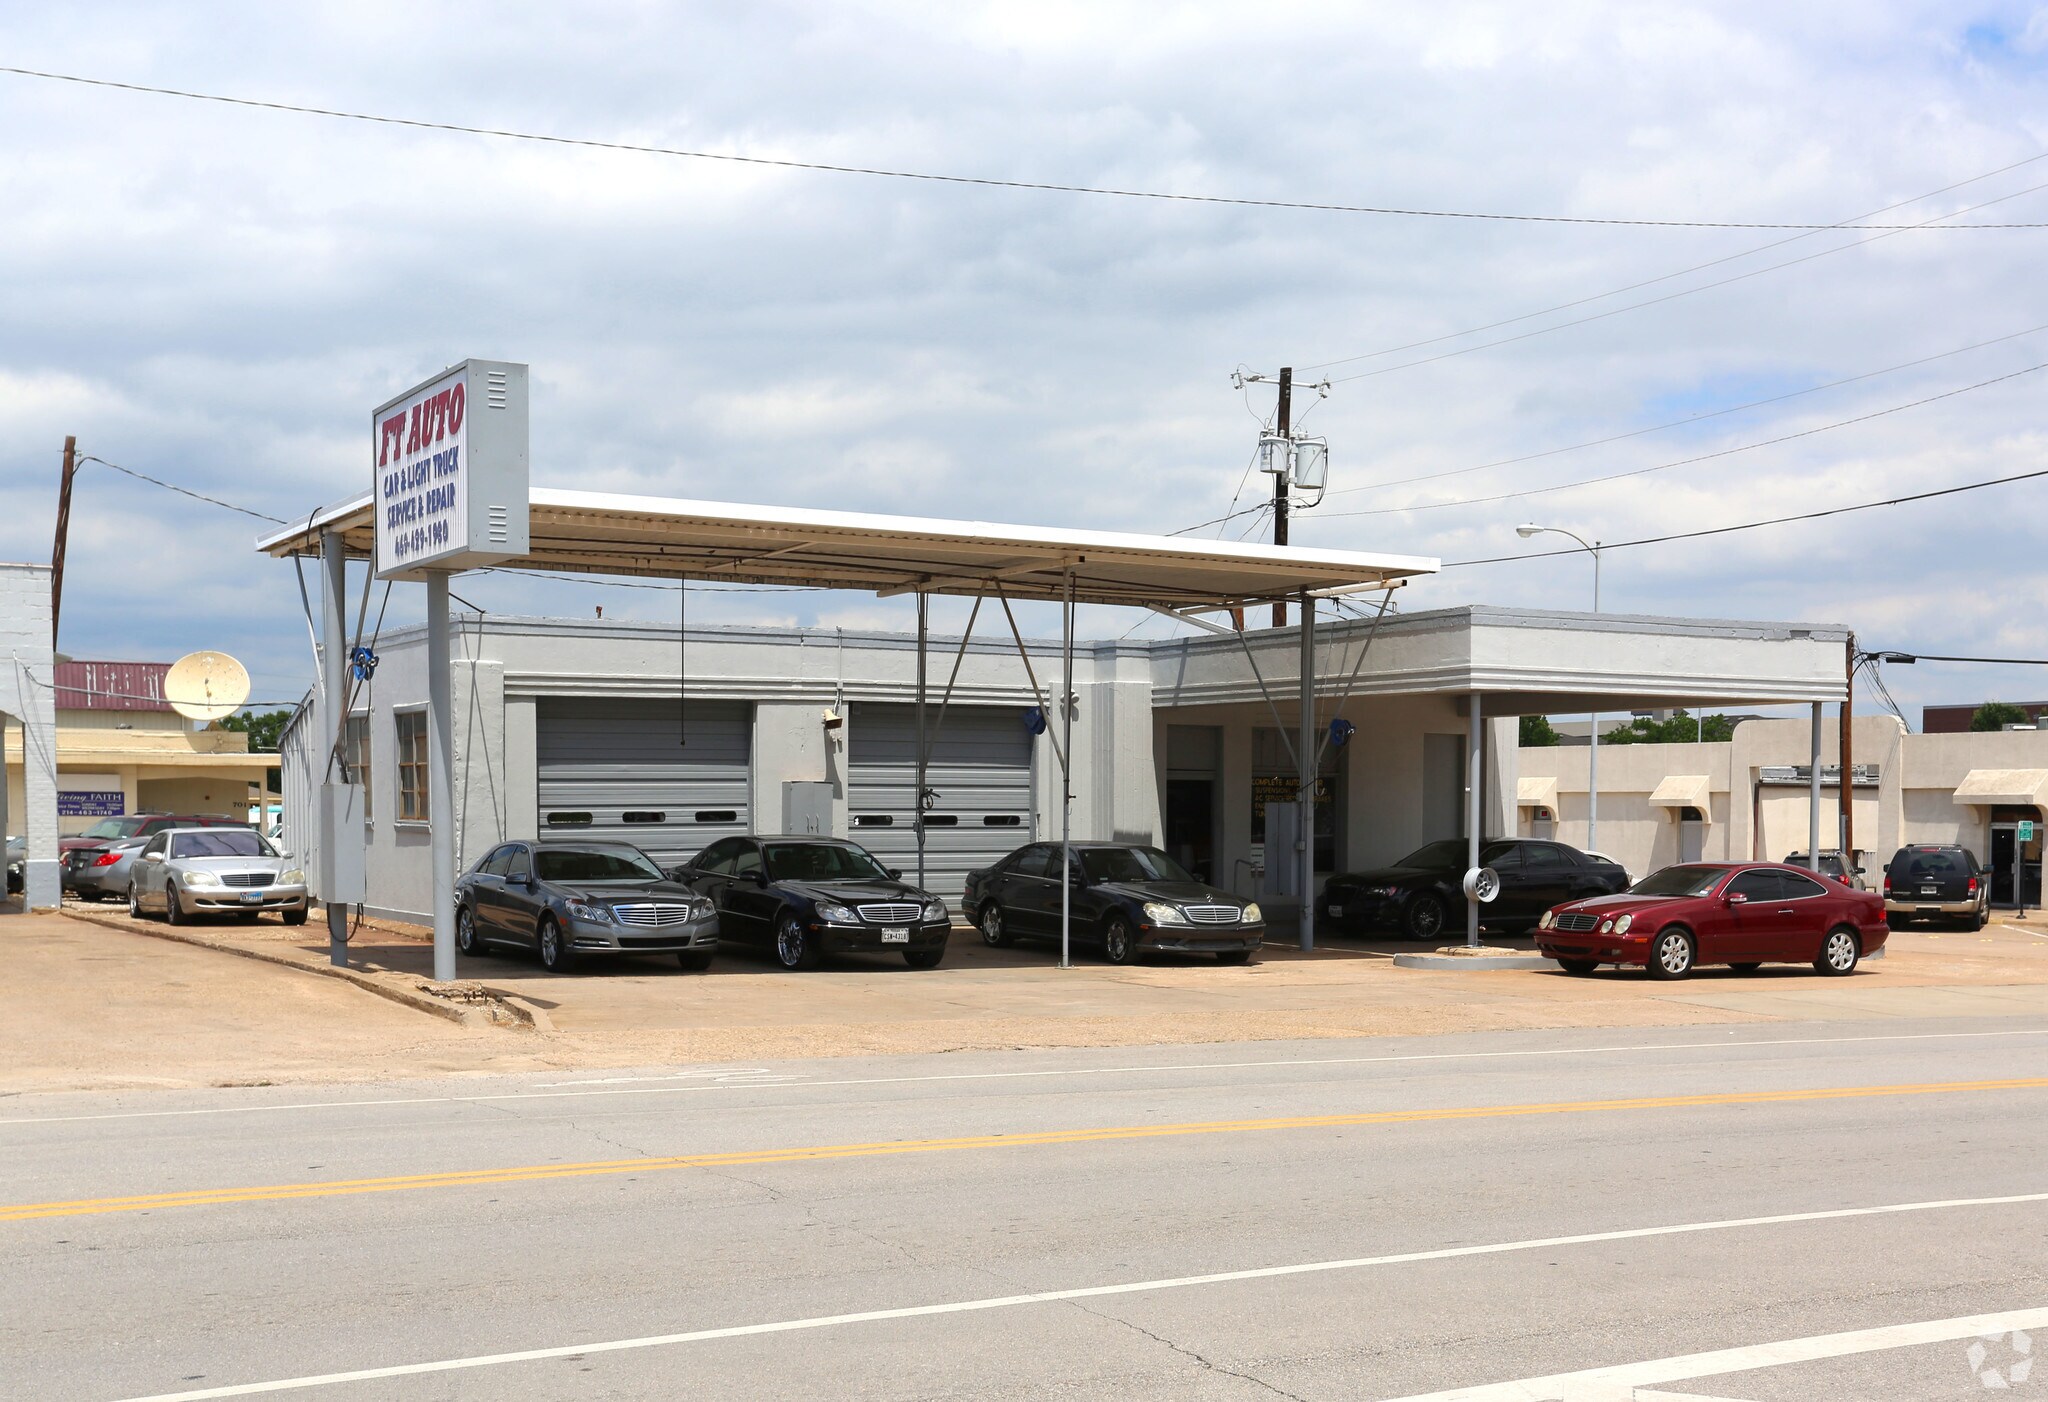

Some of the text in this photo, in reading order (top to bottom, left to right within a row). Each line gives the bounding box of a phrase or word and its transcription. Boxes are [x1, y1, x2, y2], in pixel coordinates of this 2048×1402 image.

[379, 382, 465, 467] FT AUTO
[384, 446, 459, 499] CAR & LIGHT TRUCK
[387, 482, 456, 530] SERVICE & REPAIR
[91, 793, 121, 801] FAITH
